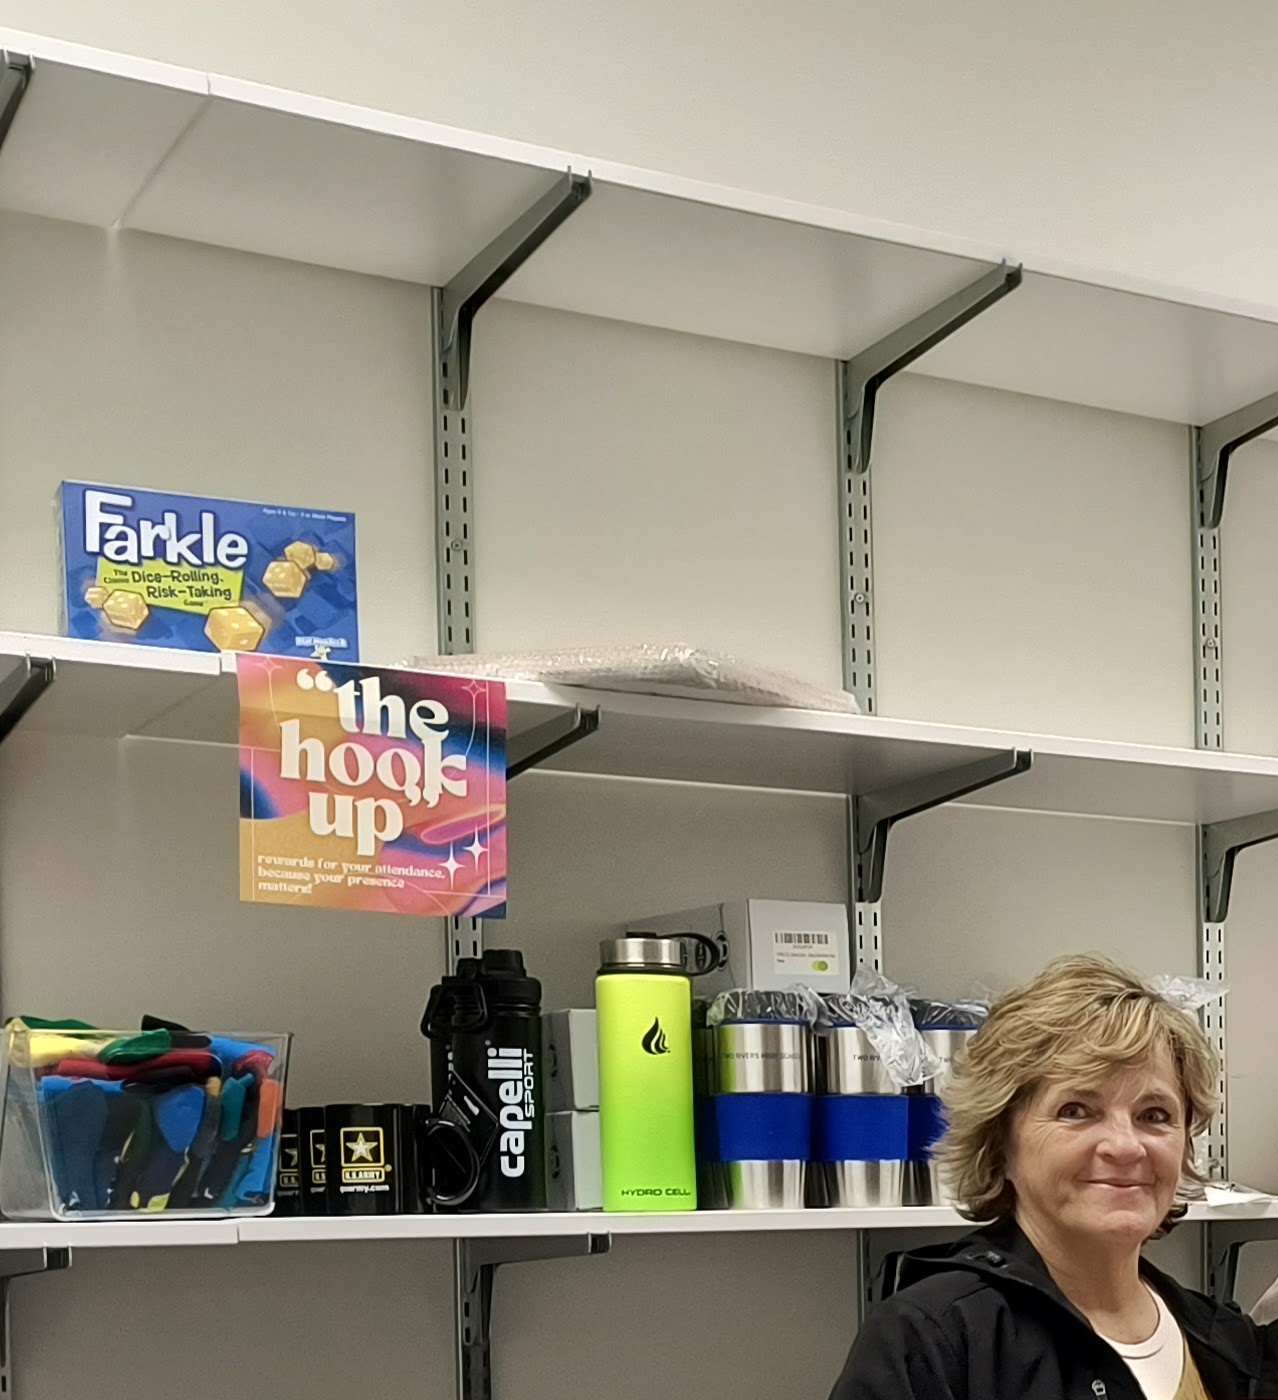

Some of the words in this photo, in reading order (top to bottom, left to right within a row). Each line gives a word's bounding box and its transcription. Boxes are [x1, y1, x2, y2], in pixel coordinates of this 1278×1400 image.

[85, 490, 248, 567] Farkle
[146, 586, 231, 601] Risk-Taking
[279, 718, 467, 799] hook
[257, 854, 315, 868] rewards
[317, 857, 337, 871] for
[341, 861, 372, 874] your
[257, 866, 311, 881] because
[313, 870, 344, 885] your
[347, 875, 405, 889] presence
[852, 1054, 869, 1062] TWO
[523, 1049, 534, 1117] SPORT
[487, 1047, 533, 1178] capelli
[665, 1188, 691, 1196] CELL
